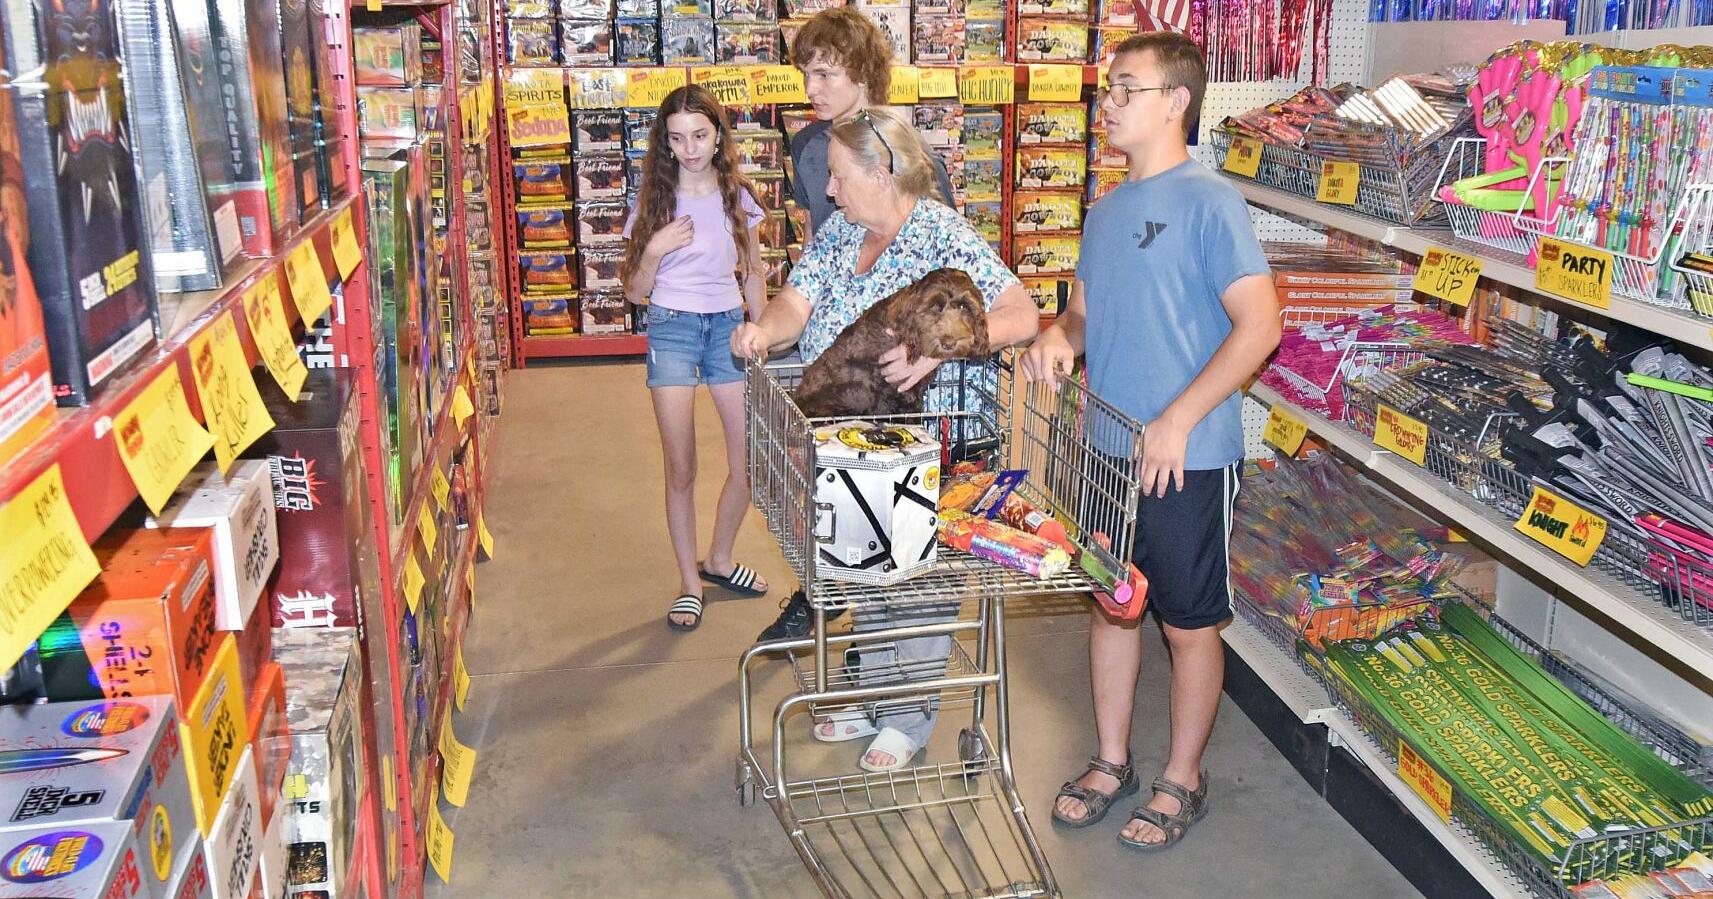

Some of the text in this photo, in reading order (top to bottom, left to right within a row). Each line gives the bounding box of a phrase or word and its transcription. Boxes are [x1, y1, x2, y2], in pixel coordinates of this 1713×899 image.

[506, 90, 562, 105] SPIRITS
[756, 82, 800, 96] EMPEROR
[221, 83, 244, 176] QUALITY
[577, 114, 620, 127] Best Friend
[577, 161, 623, 175] Best Friend
[578, 207, 624, 220] Best Friend
[1440, 252, 1471, 274] STICK
[1561, 252, 1606, 276] PARTY
[1435, 277, 1463, 297] UP
[1557, 277, 1603, 302] SPARKLERS
[581, 299, 625, 312] Best Friend
[1666, 430, 1683, 463] SWORD
[279, 457, 315, 512] BIG
[1606, 487, 1633, 513] SWORD
[1527, 510, 1569, 540] KNIGHT
[1465, 667, 1502, 702] GOLD
[1496, 703, 1575, 781] SPARKLERS
[1399, 688, 1442, 728] GOLD
[1436, 727, 1529, 809] SPARKLERS
[62, 791, 101, 807] 5
